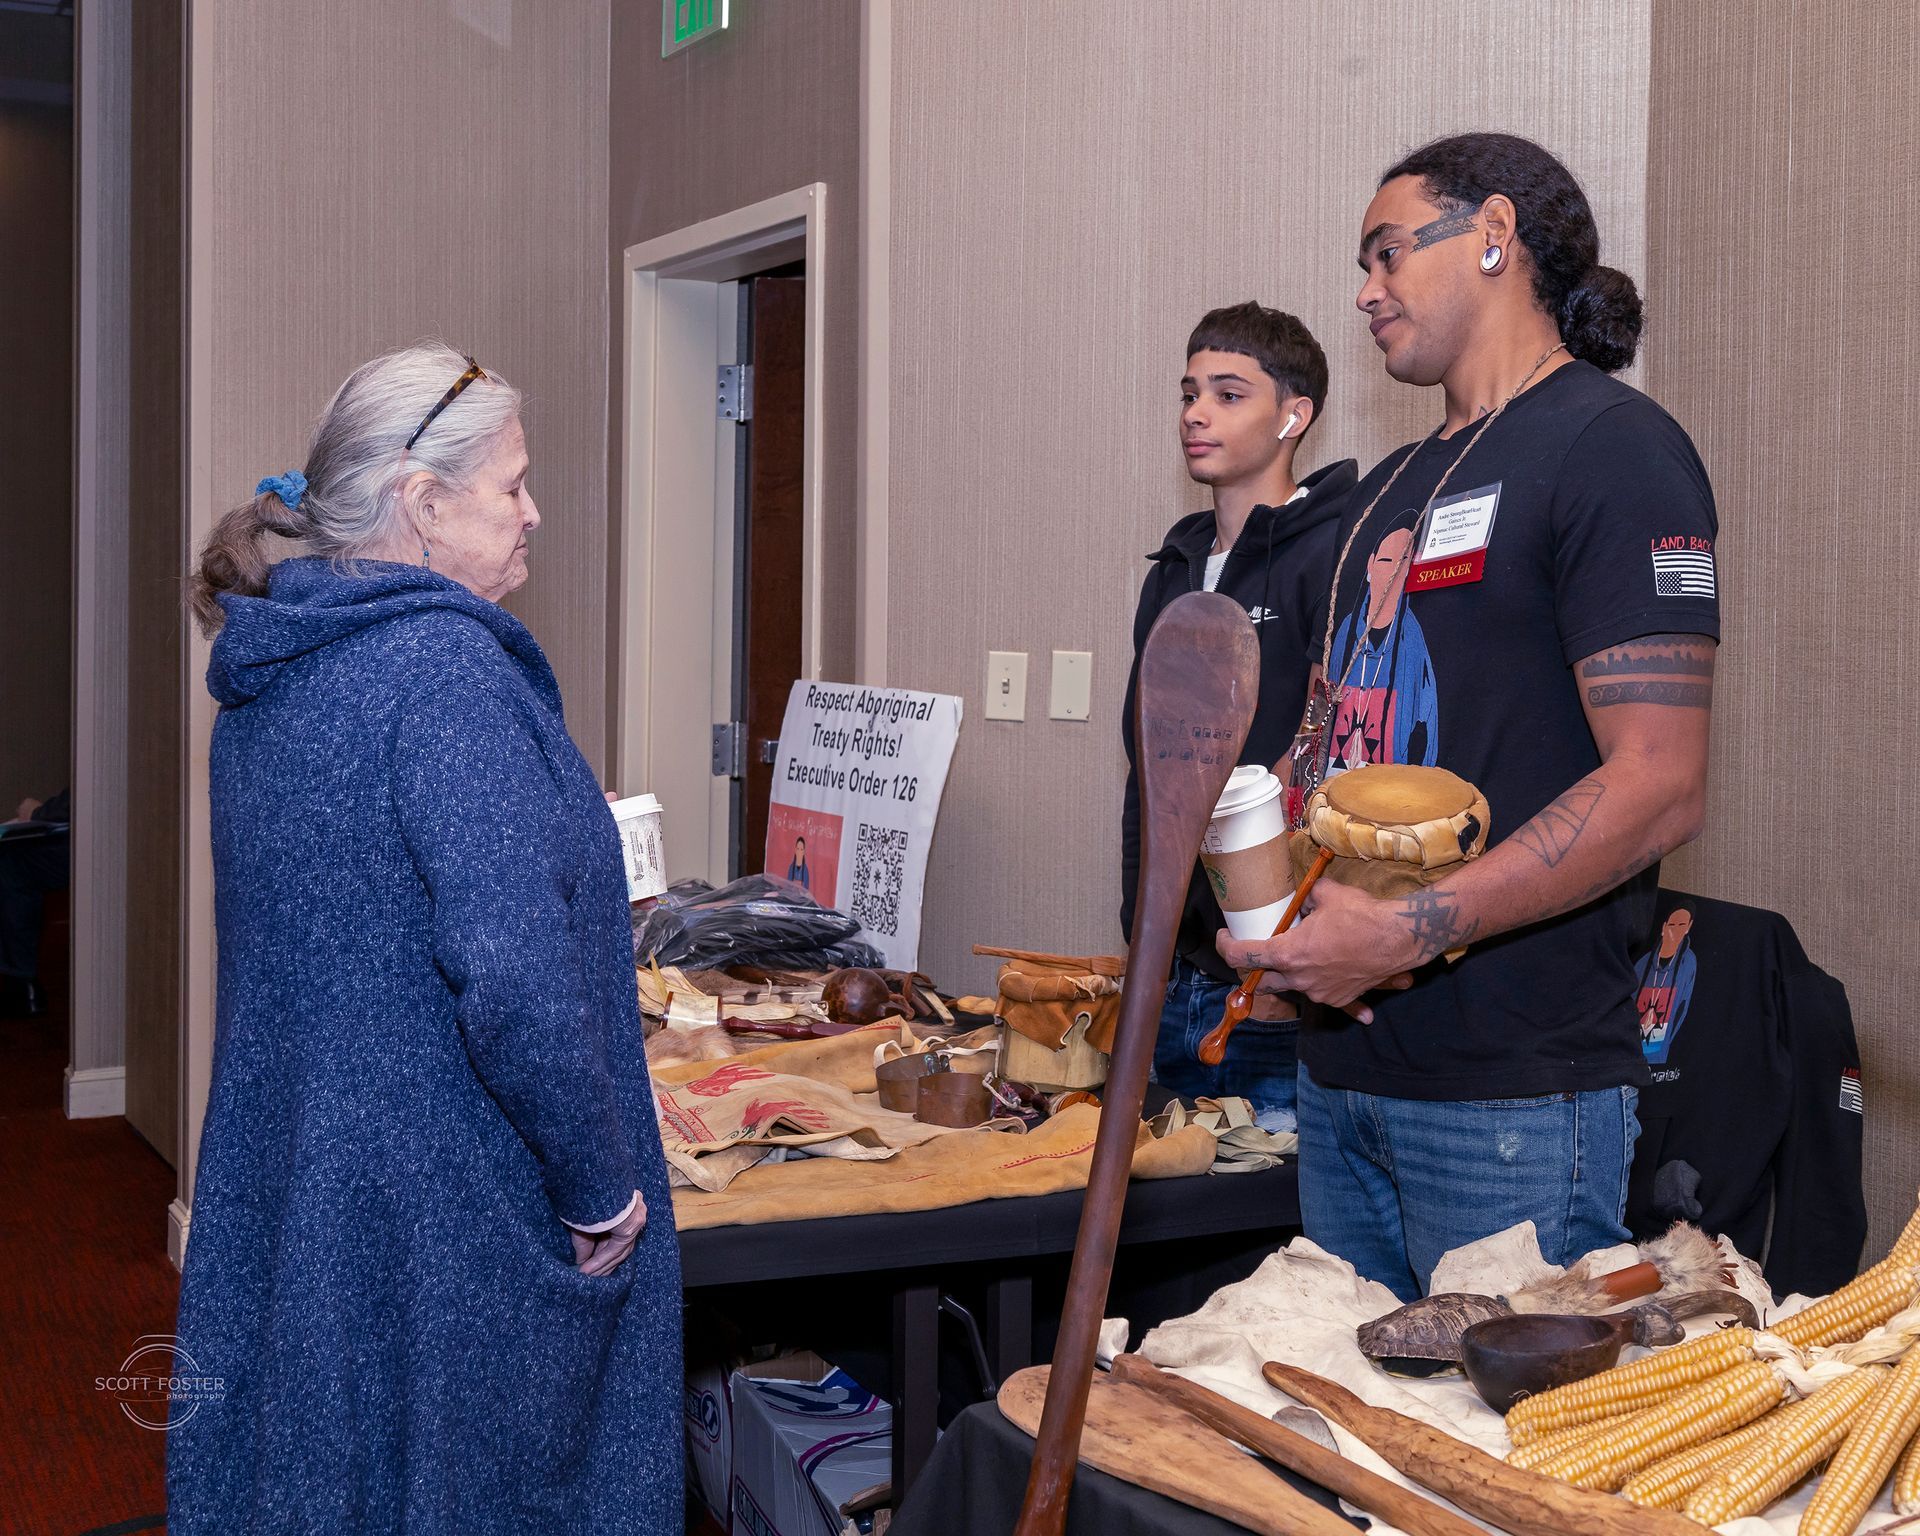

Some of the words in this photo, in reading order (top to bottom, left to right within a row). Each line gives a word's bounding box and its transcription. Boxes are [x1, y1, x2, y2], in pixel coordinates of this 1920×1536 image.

[1651, 535, 1685, 551] LAND
[1416, 562, 1472, 582] SPEAKER
[805, 684, 855, 715] Respect
[855, 690, 936, 723] Aboriginal
[812, 723, 850, 757] Treaty
[851, 728, 903, 761] Rights!
[787, 758, 845, 790] Executive
[849, 768, 887, 797] Order
[892, 774, 918, 802] 126
